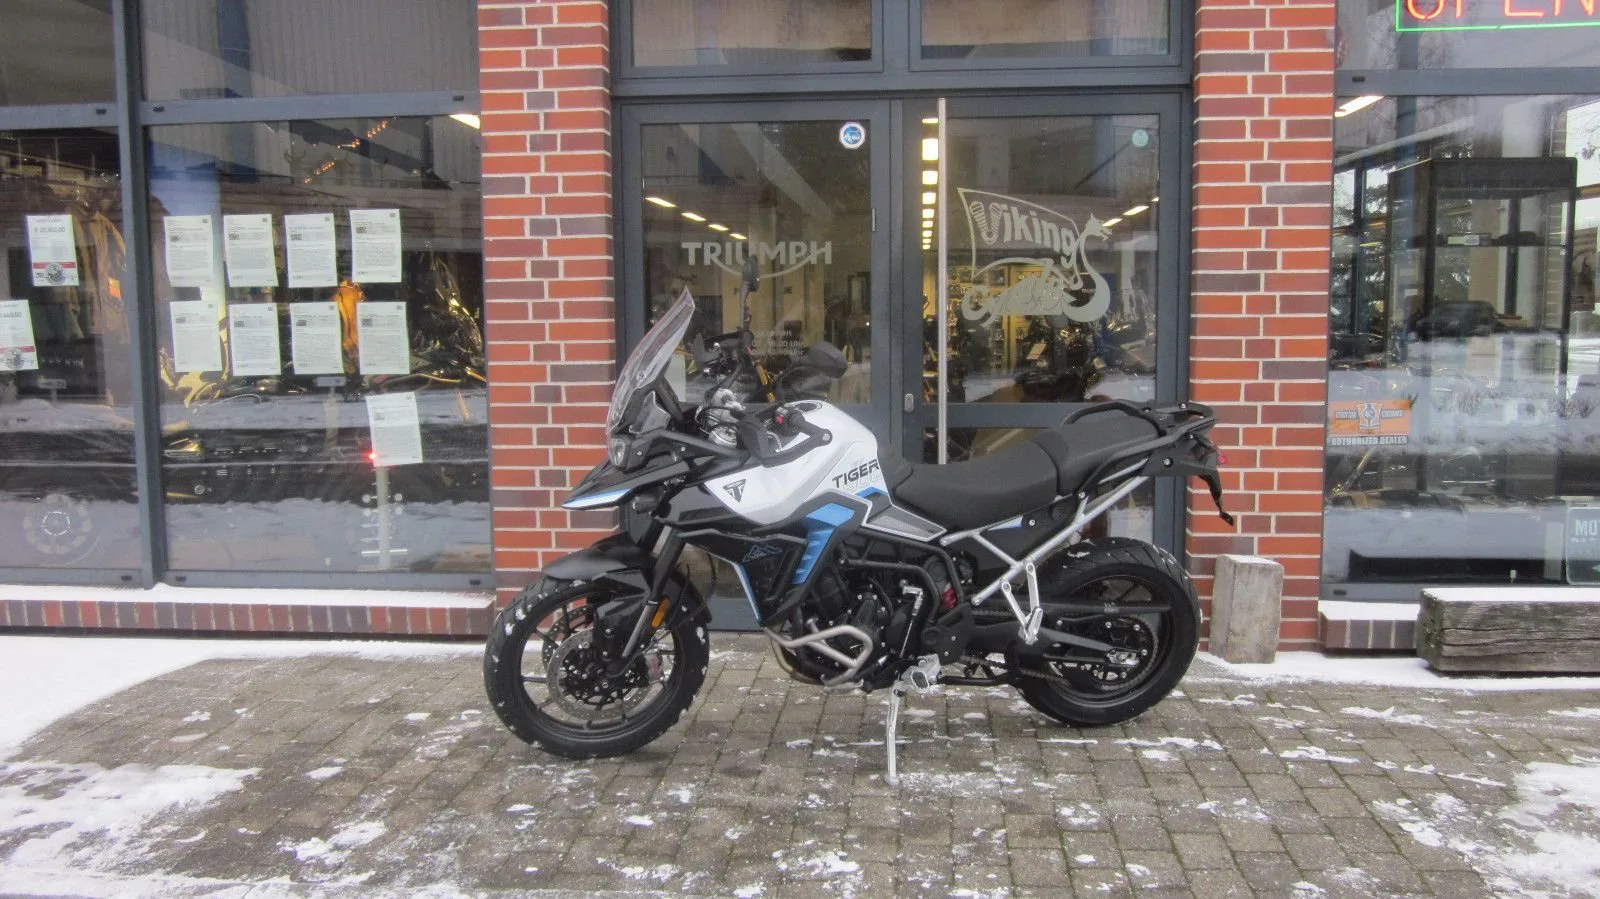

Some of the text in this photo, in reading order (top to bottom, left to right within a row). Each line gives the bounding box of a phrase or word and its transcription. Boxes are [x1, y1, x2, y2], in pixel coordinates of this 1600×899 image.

[969, 200, 1076, 269] Viking
[681, 240, 833, 271] TRIUMPH
[1331, 435, 1407, 446] AUTHORIZED DEALER
[832, 459, 880, 488] TIGER
[1576, 519, 1600, 536] MO
